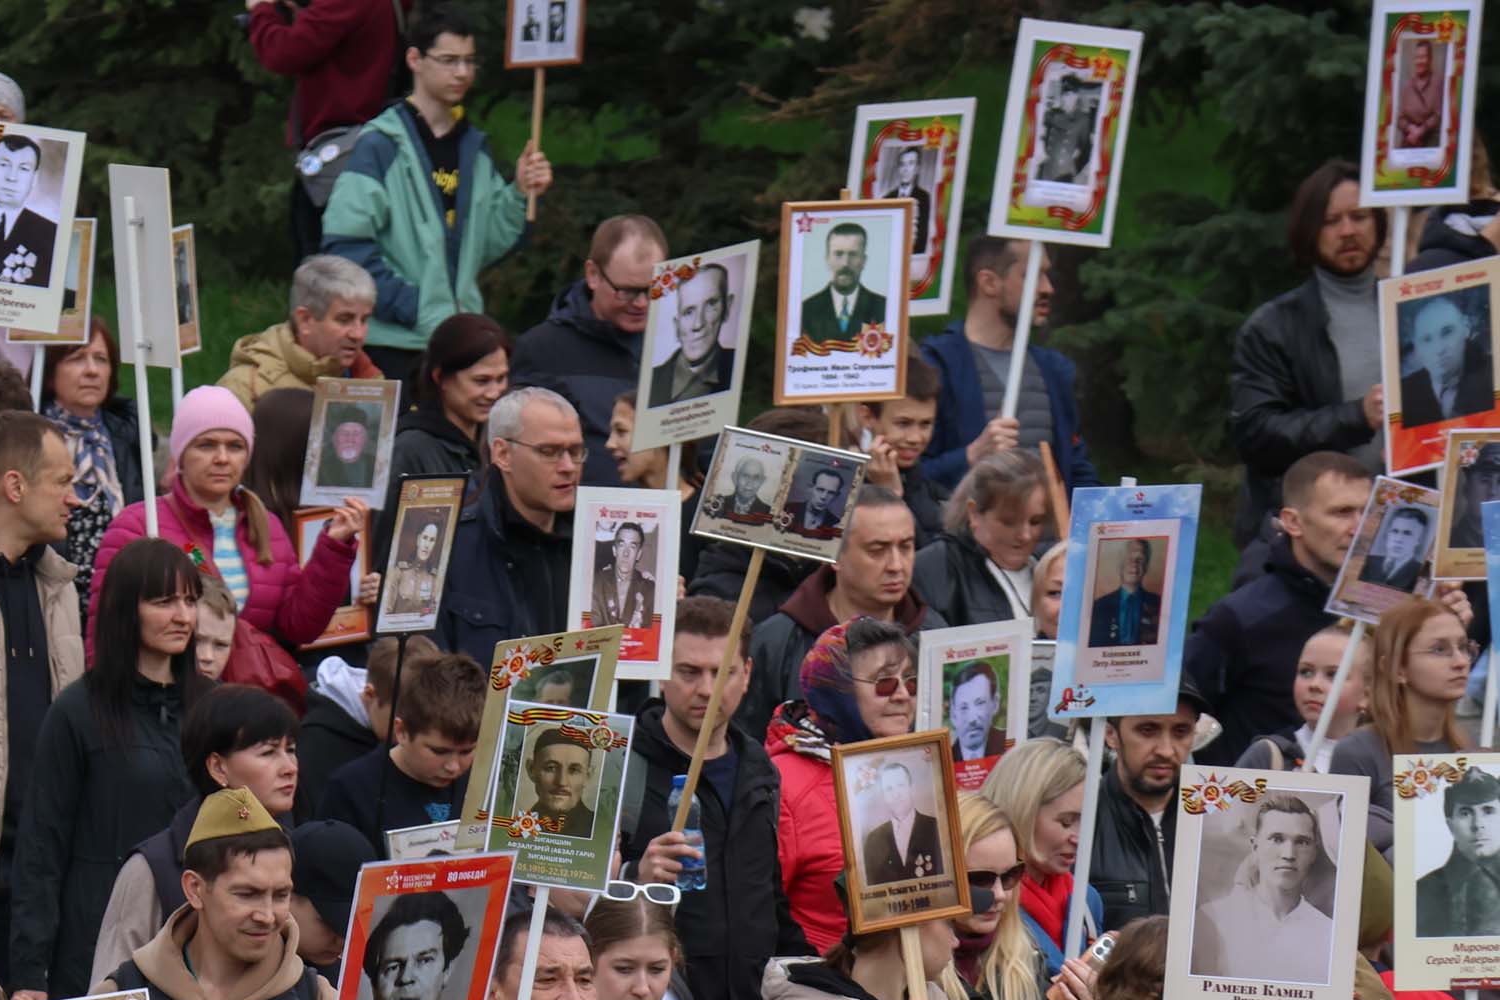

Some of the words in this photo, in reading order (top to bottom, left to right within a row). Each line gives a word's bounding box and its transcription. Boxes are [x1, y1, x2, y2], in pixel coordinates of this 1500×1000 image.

[447, 871, 458, 883] 80
[457, 869, 488, 881] ПОБЕДА!
[1426, 954, 1460, 966] Сергей
